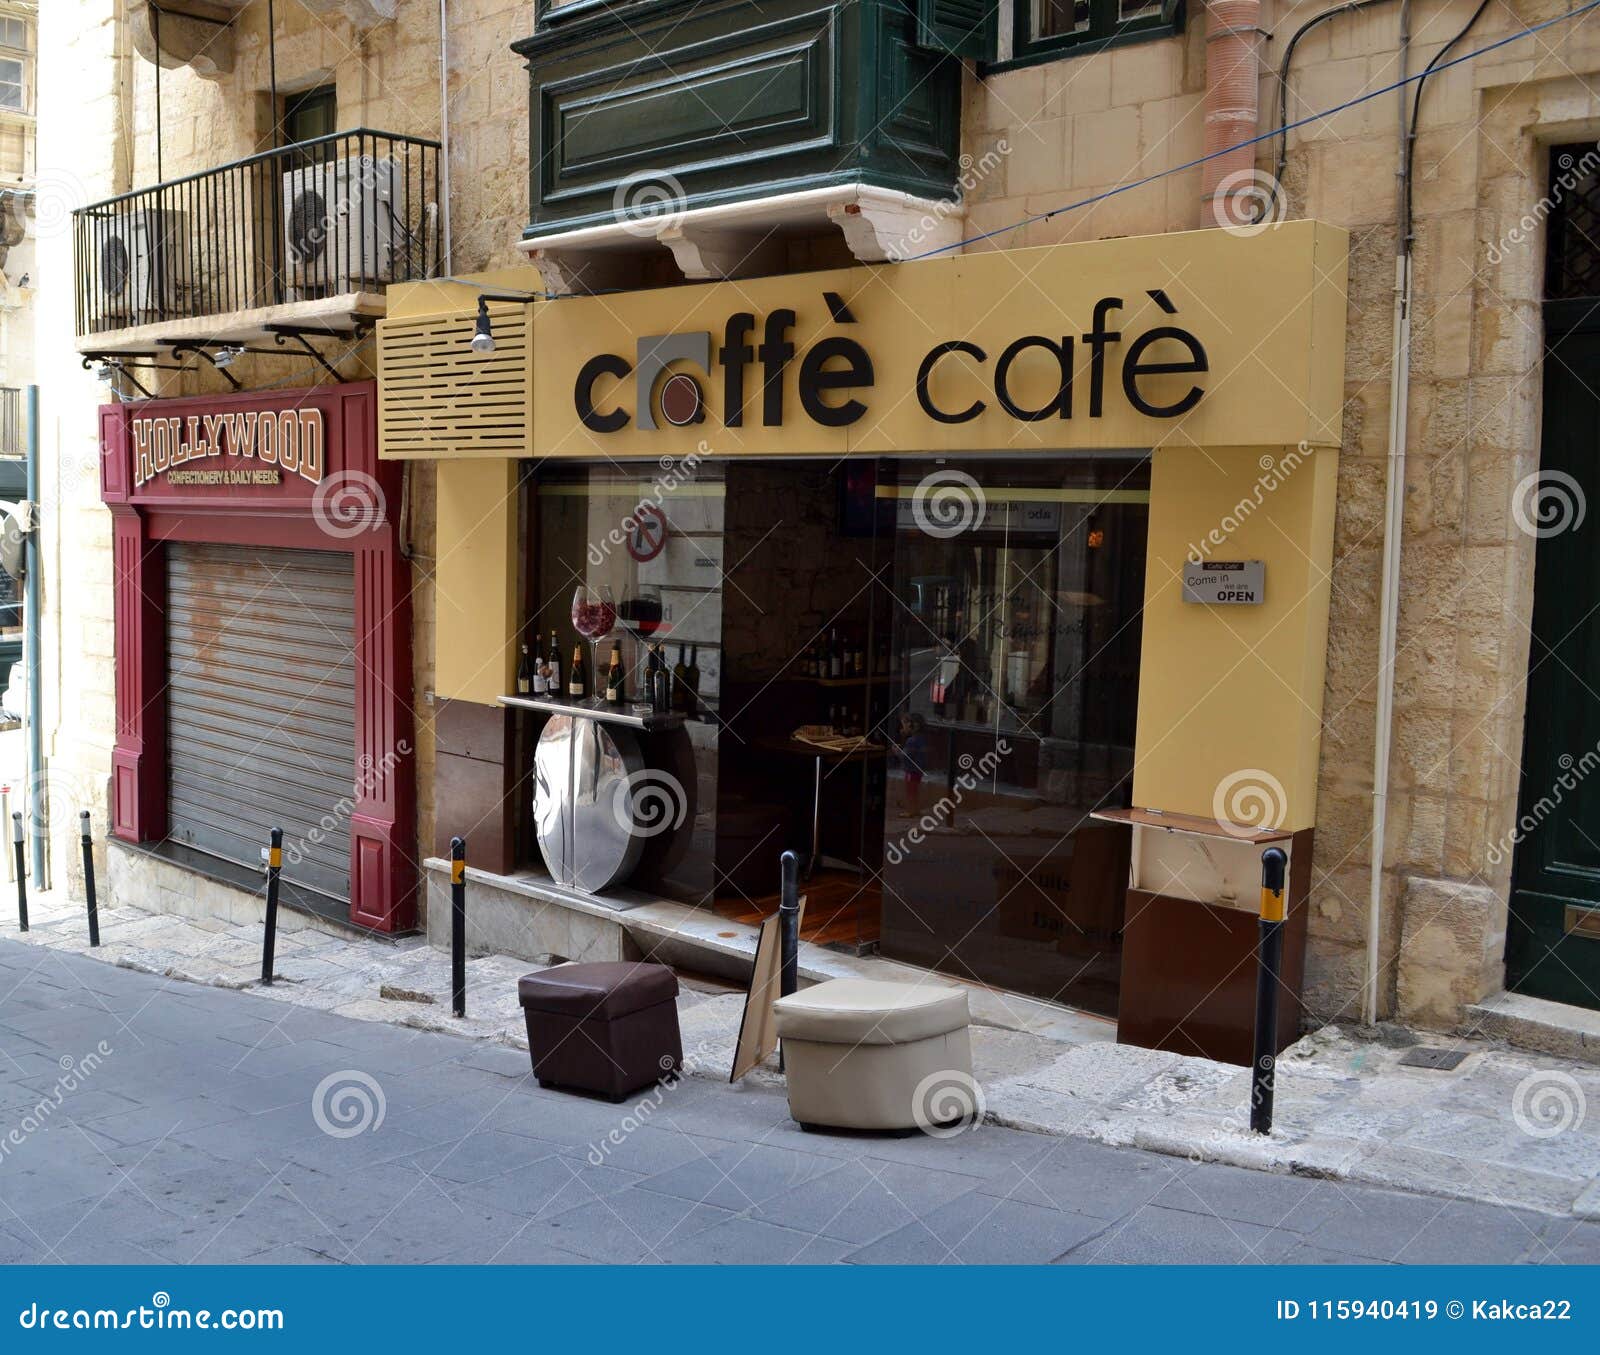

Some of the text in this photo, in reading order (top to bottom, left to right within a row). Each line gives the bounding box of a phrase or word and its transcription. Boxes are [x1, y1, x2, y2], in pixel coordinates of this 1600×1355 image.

[916, 289, 1208, 424] cafè
[133, 407, 323, 487] HOLLYWOOD
[167, 470, 223, 485] CONFECTIONERY
[230, 470, 251, 484] DAILY
[1187, 574, 1229, 587] Come in
[1217, 591, 1254, 601] OPEN
